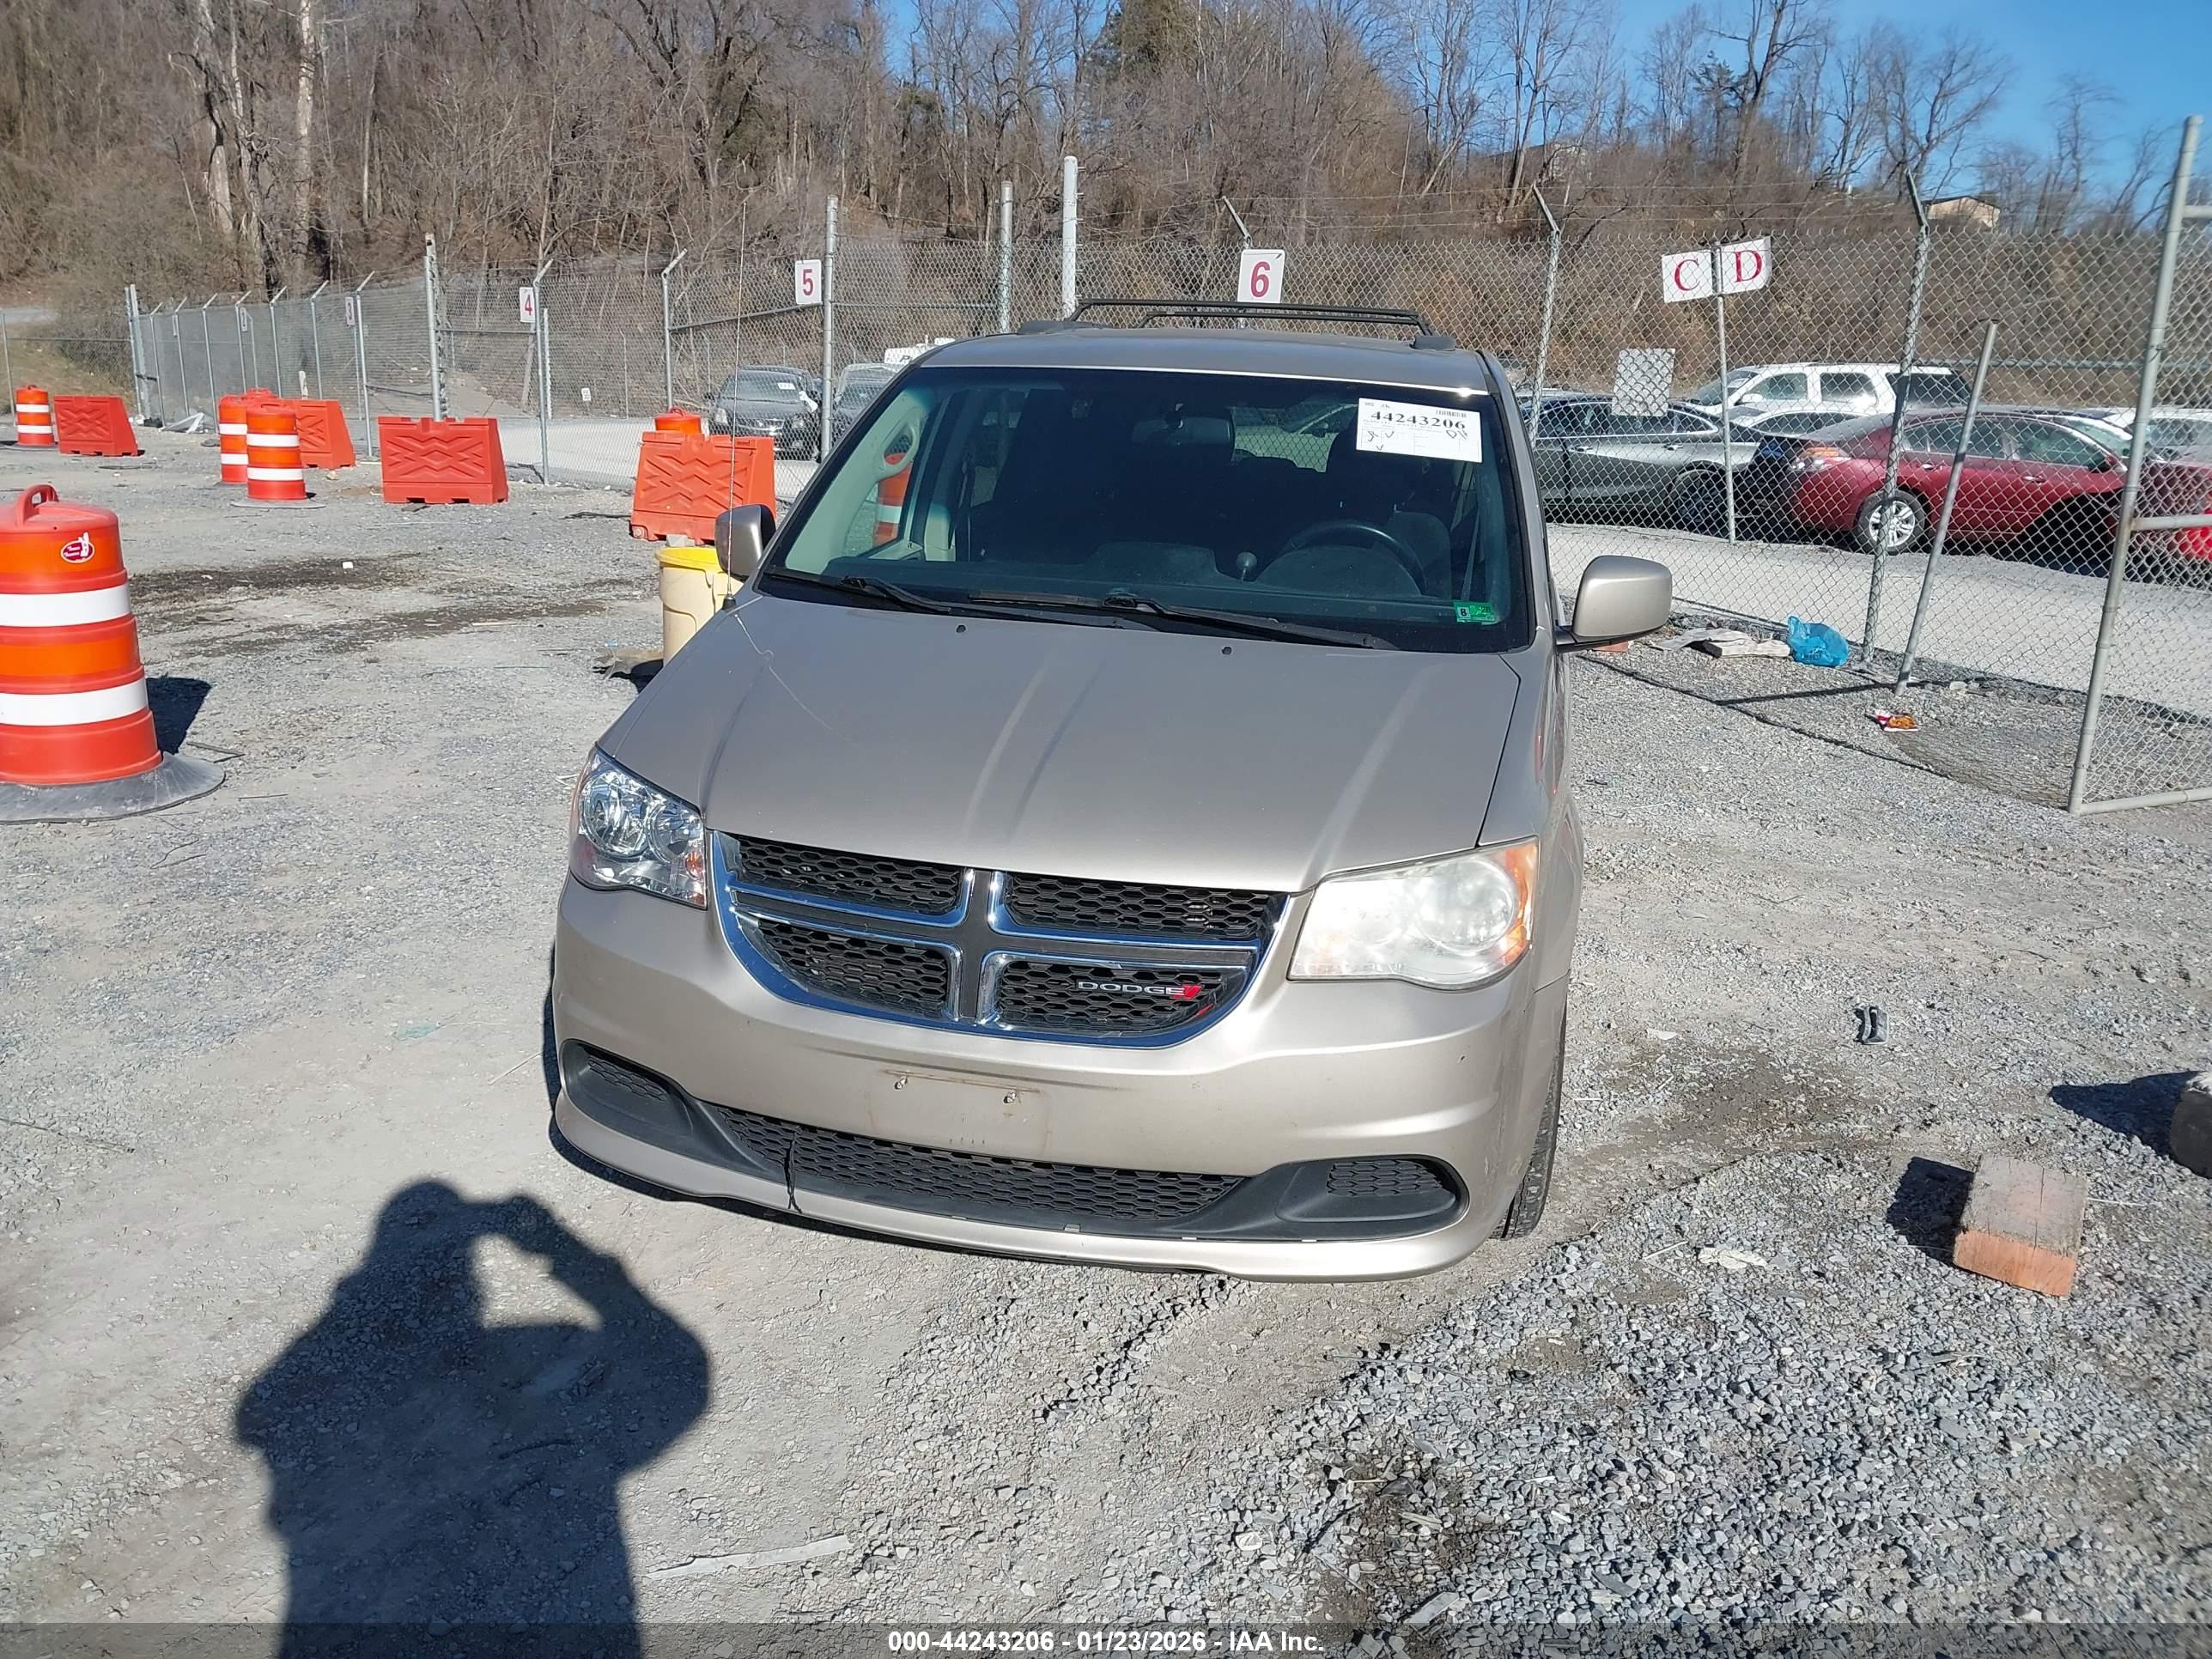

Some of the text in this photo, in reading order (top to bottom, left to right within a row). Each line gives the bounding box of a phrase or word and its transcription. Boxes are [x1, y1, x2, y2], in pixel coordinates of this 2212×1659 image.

[1674, 258, 1700, 291] C
[1735, 250, 1762, 283] D
[803, 268, 813, 295] 5
[1250, 260, 1271, 298] 6
[525, 294, 532, 315] 4
[1370, 411, 1466, 430] 44243206
[1460, 608, 1468, 617] 8
[1078, 981, 1185, 996] DODGE
